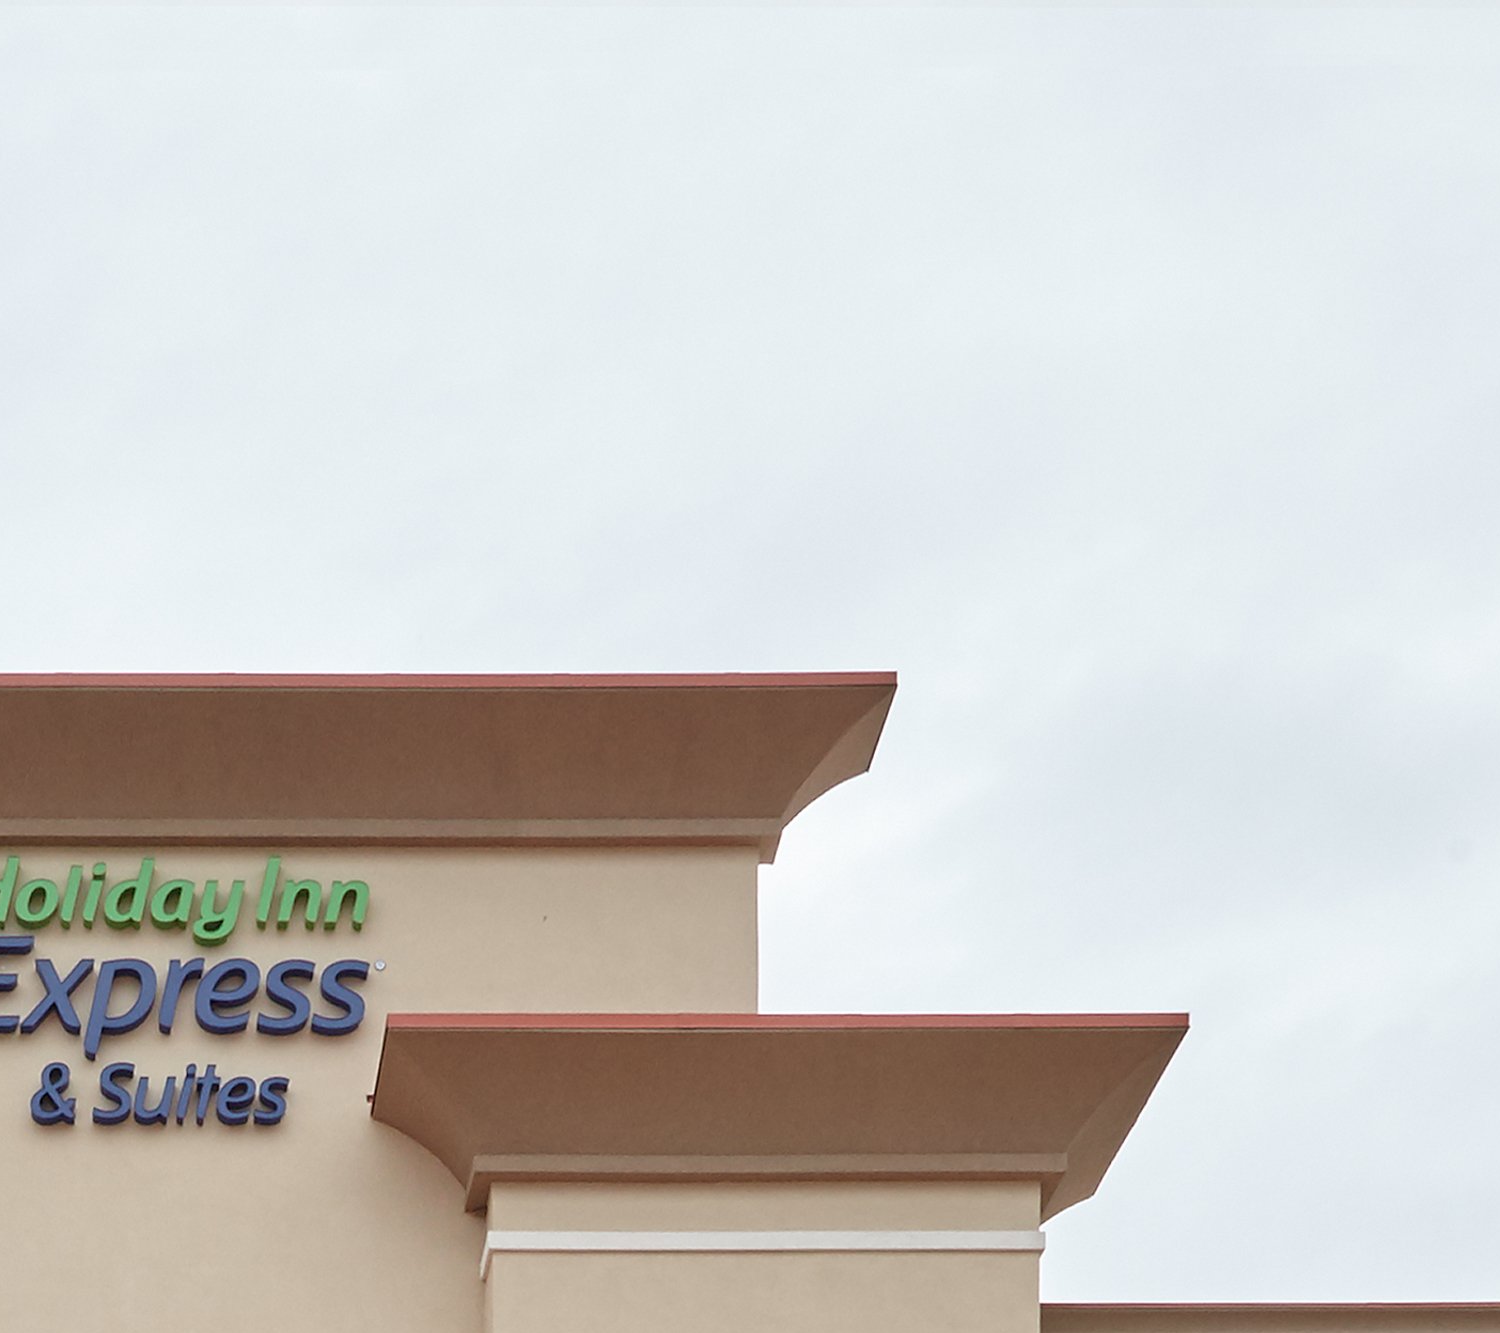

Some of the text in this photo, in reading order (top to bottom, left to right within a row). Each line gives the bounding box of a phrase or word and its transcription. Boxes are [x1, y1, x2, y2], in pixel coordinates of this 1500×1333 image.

[256, 855, 370, 931] Inn
[31, 1061, 289, 1126] & Suites
